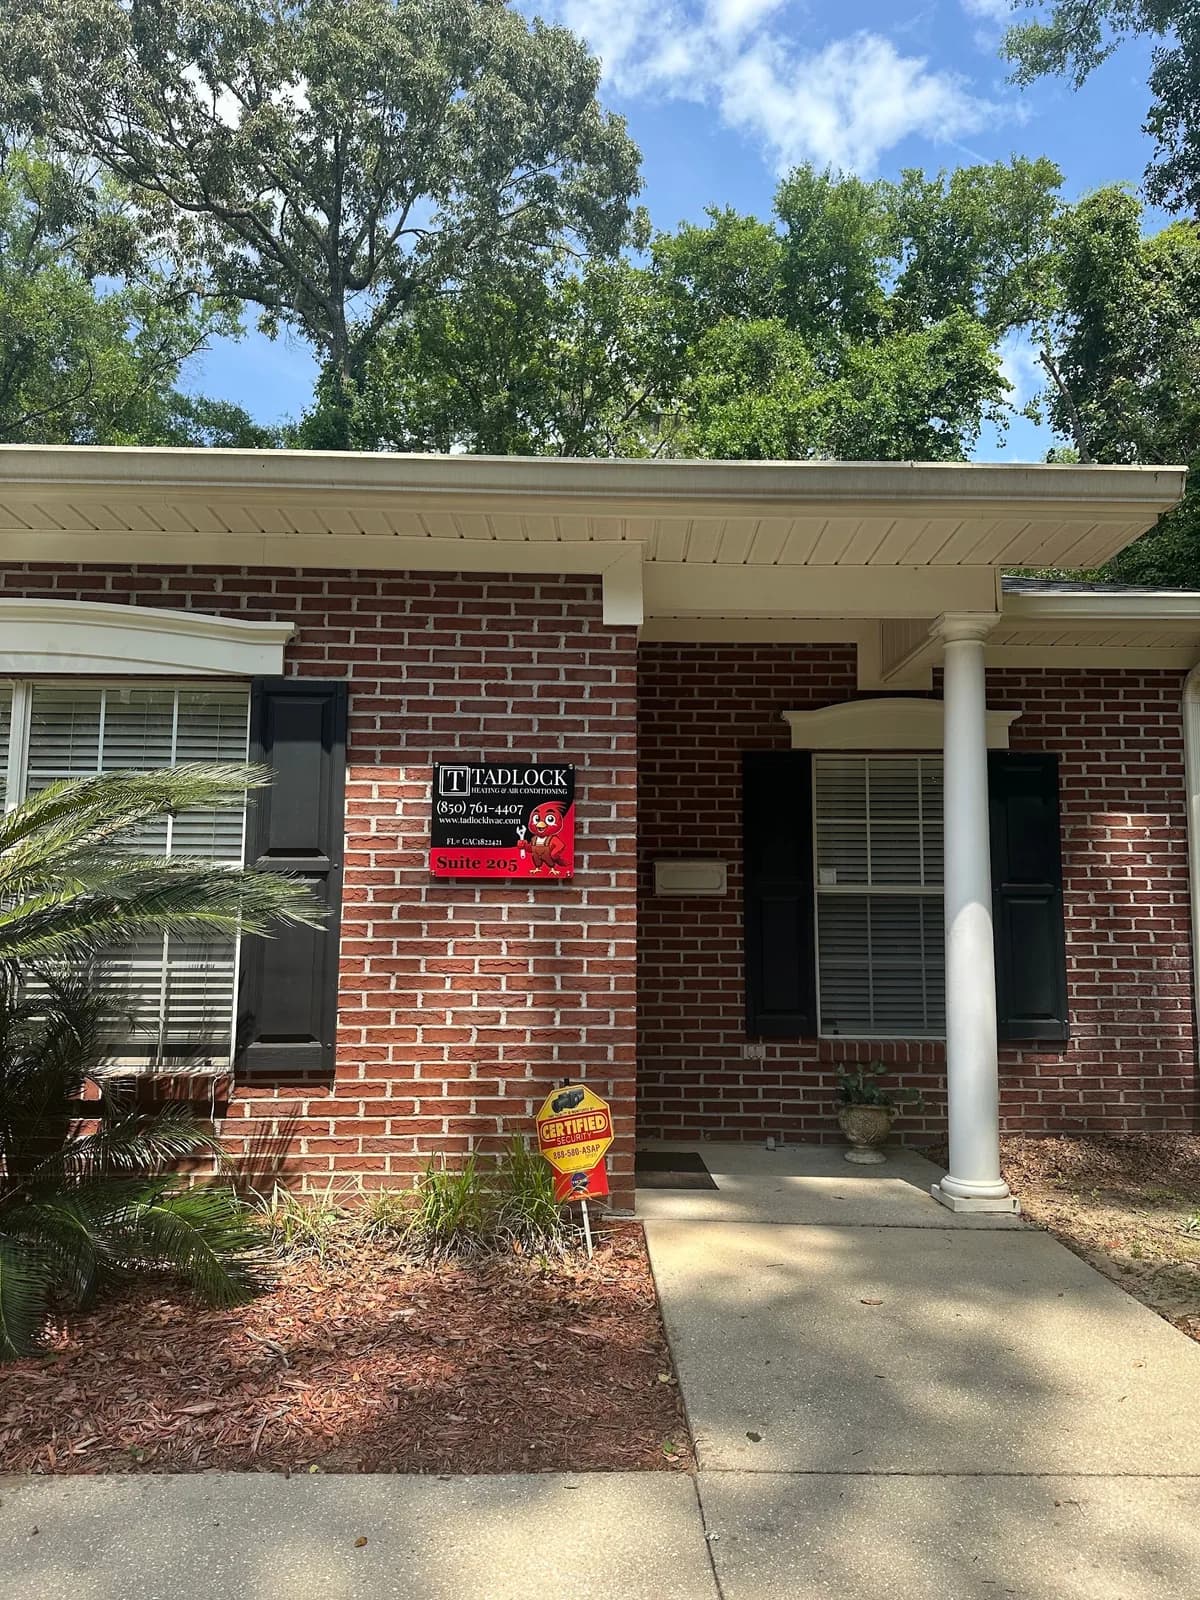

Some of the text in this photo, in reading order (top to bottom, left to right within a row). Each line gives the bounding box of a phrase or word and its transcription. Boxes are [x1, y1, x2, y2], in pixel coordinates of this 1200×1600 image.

[447, 770, 464, 791] T
[471, 768, 568, 786] TADLOCK
[436, 801, 524, 816] (850) 761-4407
[439, 817, 521, 825] www.tadlockhvac.com
[436, 856, 518, 872] Suite 205
[542, 1115, 605, 1139] CERTIFIED
[556, 1132, 592, 1145] SECURITY
